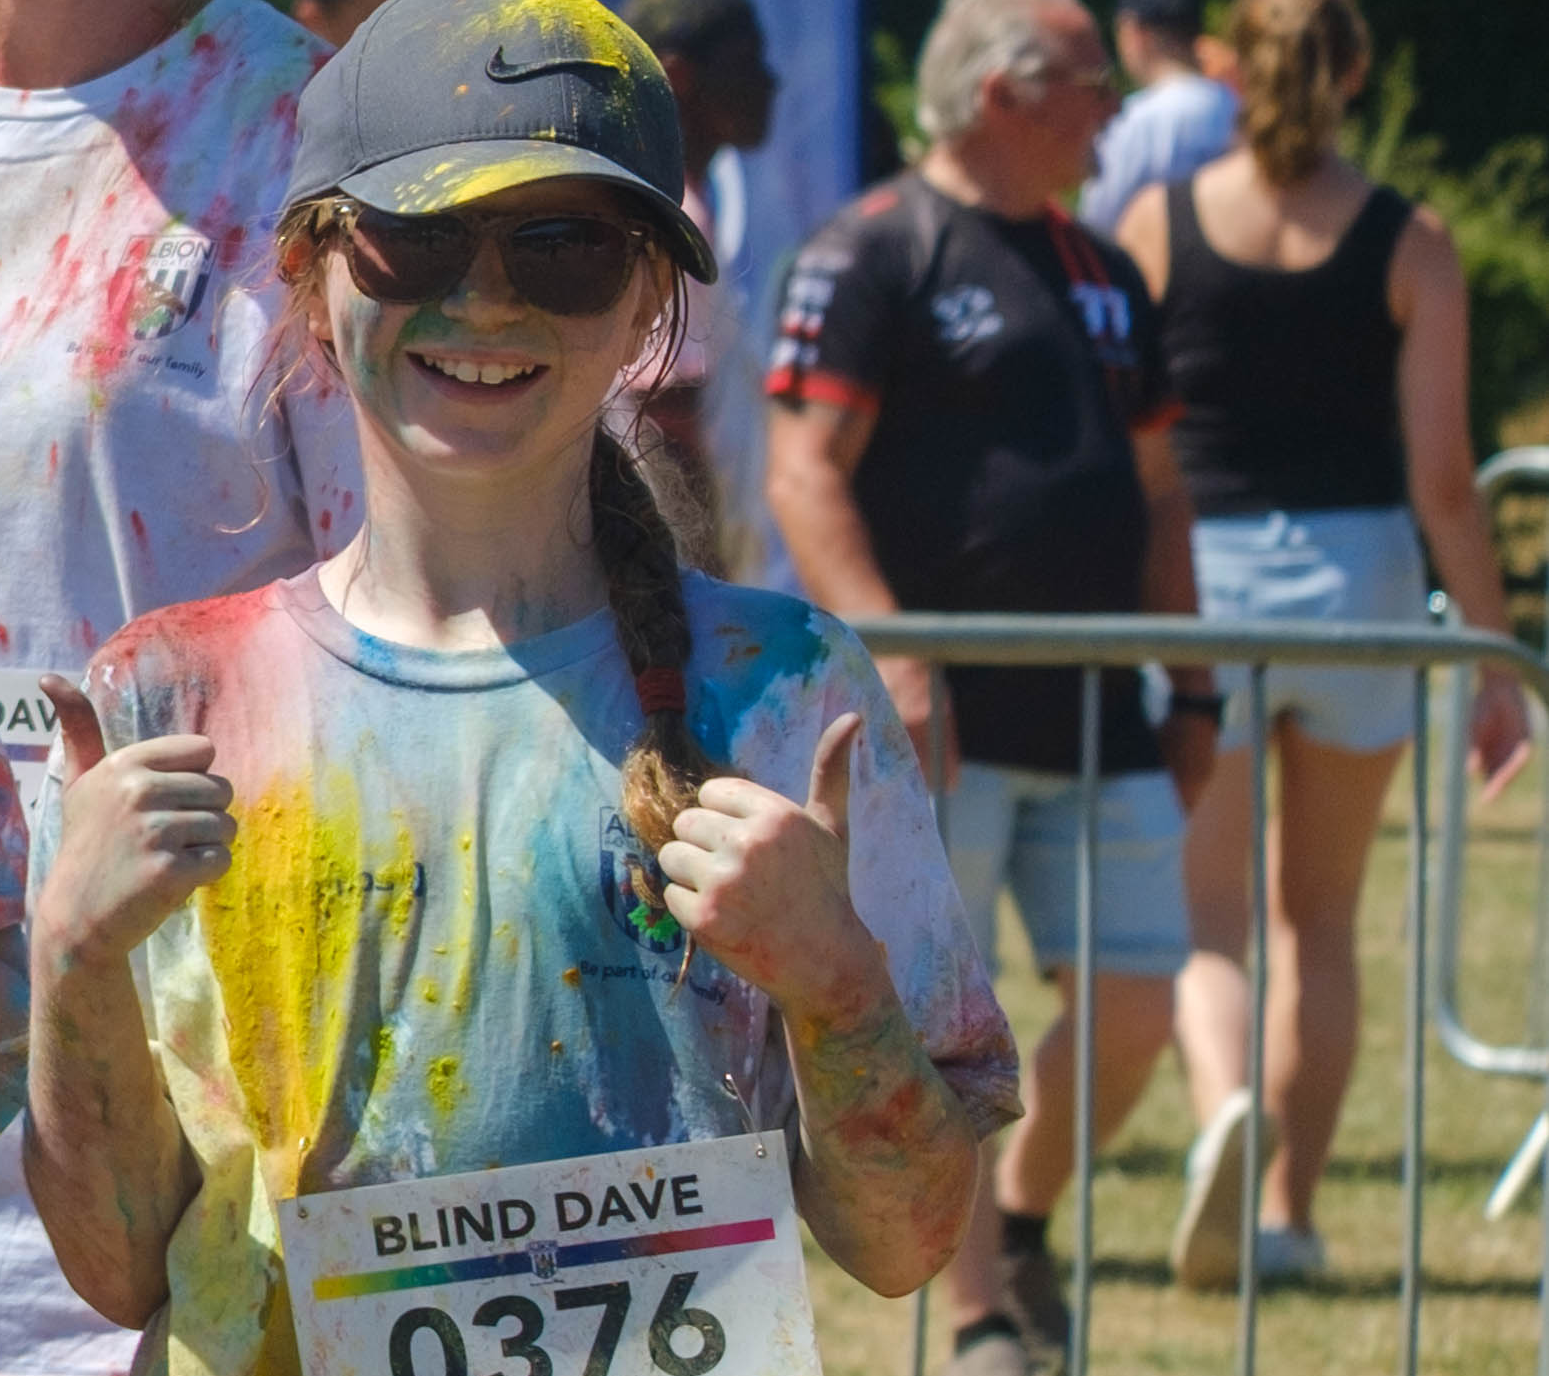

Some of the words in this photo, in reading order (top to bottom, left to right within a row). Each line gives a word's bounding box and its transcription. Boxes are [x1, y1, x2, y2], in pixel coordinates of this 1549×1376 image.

[165, 355, 208, 379] family
[580, 959, 598, 977] Be
[601, 963, 637, 983] part
[641, 966, 658, 981] of
[372, 1197, 537, 1257] BLIND
[554, 1174, 704, 1232] DAVE
